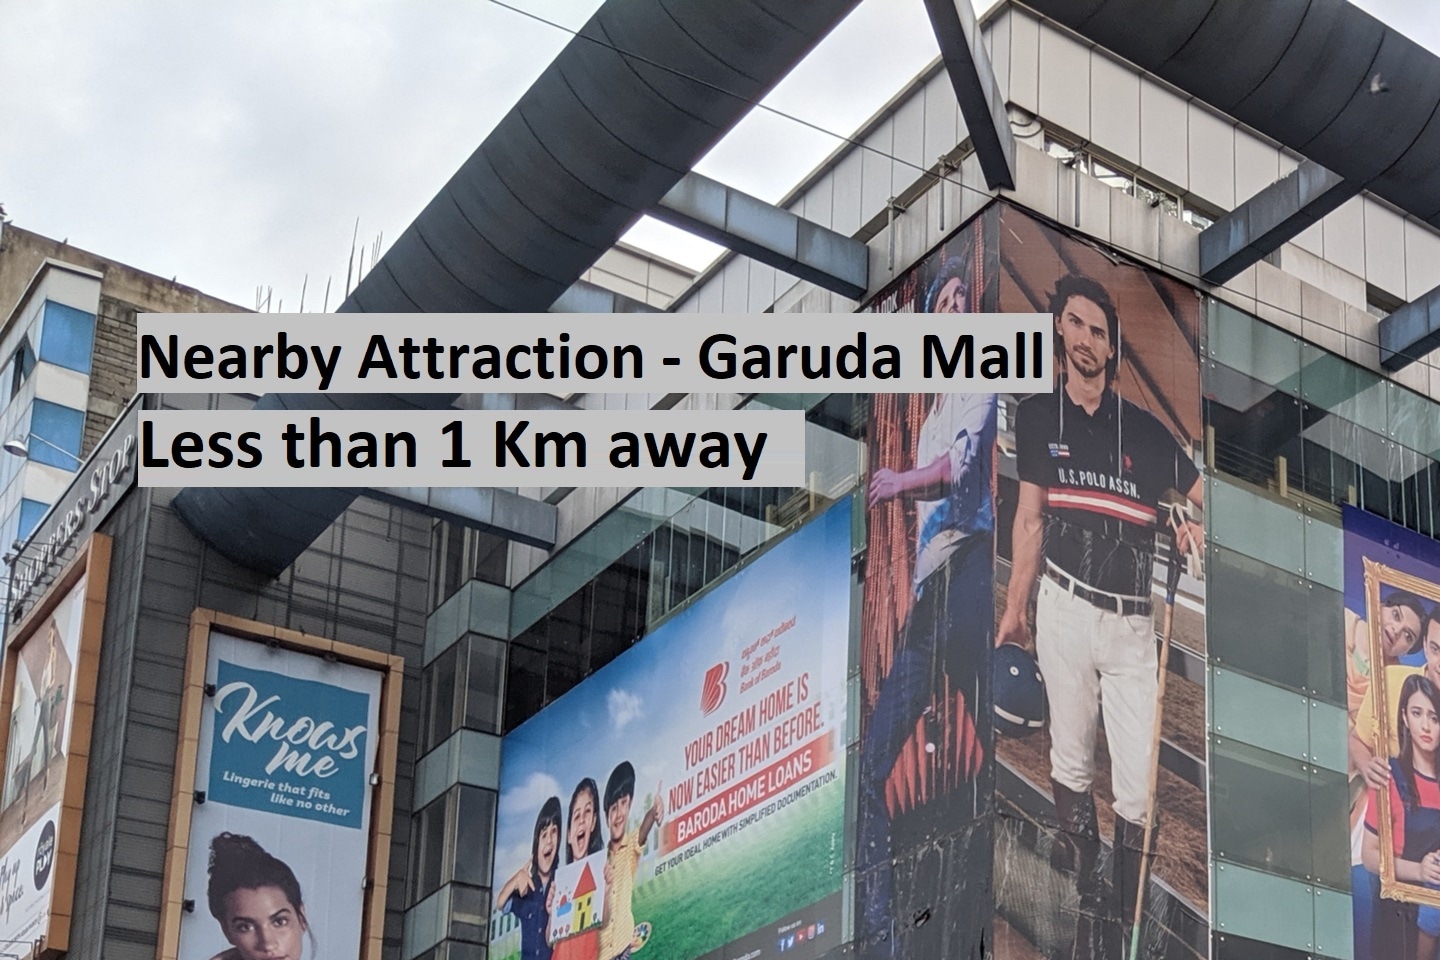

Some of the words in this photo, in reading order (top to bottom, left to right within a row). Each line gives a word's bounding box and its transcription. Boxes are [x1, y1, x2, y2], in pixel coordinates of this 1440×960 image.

[87, 434, 136, 514] STOP
[1058, 467, 1079, 486] U.S.
[1079, 470, 1106, 488] POLO
[1109, 475, 1140, 499] ASSN.
[214, 681, 367, 760] Knows
[265, 741, 339, 778] me
[669, 775, 694, 815] NOW
[696, 751, 735, 799] EASIER
[739, 731, 770, 775] THAN
[774, 701, 825, 755] BEFORE.
[685, 731, 713, 771] YOUR
[716, 705, 756, 751] DREAM
[759, 680, 794, 727] HOME
[797, 672, 809, 704] IS
[223, 771, 275, 790] Lingerie
[278, 782, 306, 796] that
[308, 787, 331, 801] fits
[270, 793, 294, 807] like
[296, 799, 312, 810] no
[314, 801, 350, 817] other
[655, 862, 667, 876] GET
[667, 849, 684, 868] YOUR
[684, 842, 702, 861] IDEAL
[703, 833, 721, 851] HOME
[721, 825, 738, 842] WITH
[738, 805, 776, 832] SIMPLIFIED
[777, 769, 838, 811] DOCUMENTATION.
[677, 799, 727, 843] BARODA
[728, 776, 765, 814] HOME
[768, 749, 812, 793] LOANS
